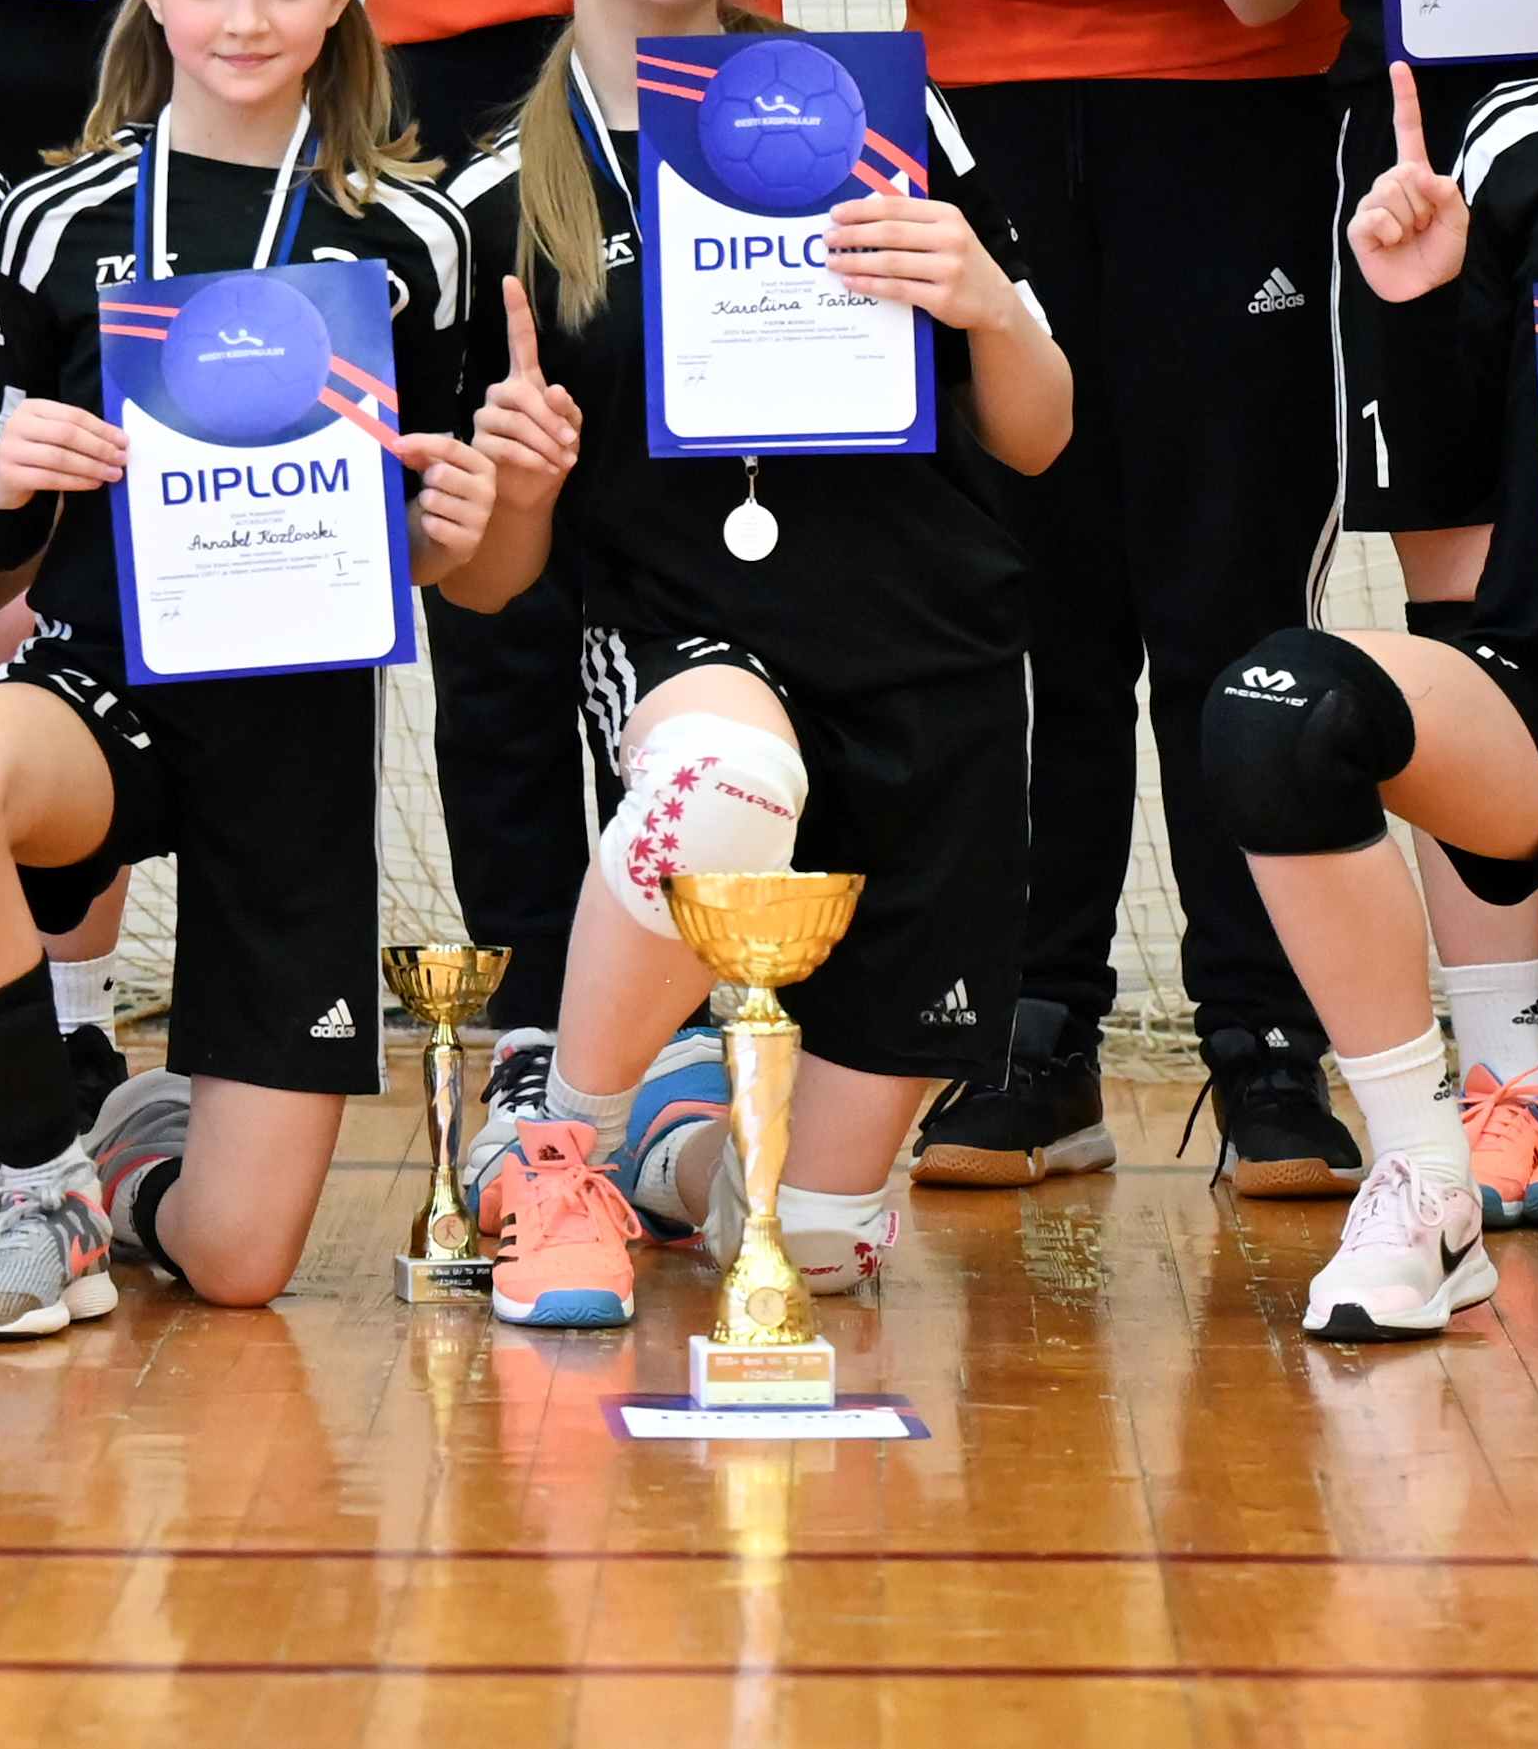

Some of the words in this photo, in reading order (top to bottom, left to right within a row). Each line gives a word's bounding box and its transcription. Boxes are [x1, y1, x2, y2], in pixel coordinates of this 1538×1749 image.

[694, 234, 829, 271] DIPLO
[1248, 293, 1305, 314] adidas
[162, 459, 349, 505] DIPLOM
[186, 530, 251, 551] Annabel
[310, 1024, 356, 1038] adidas
